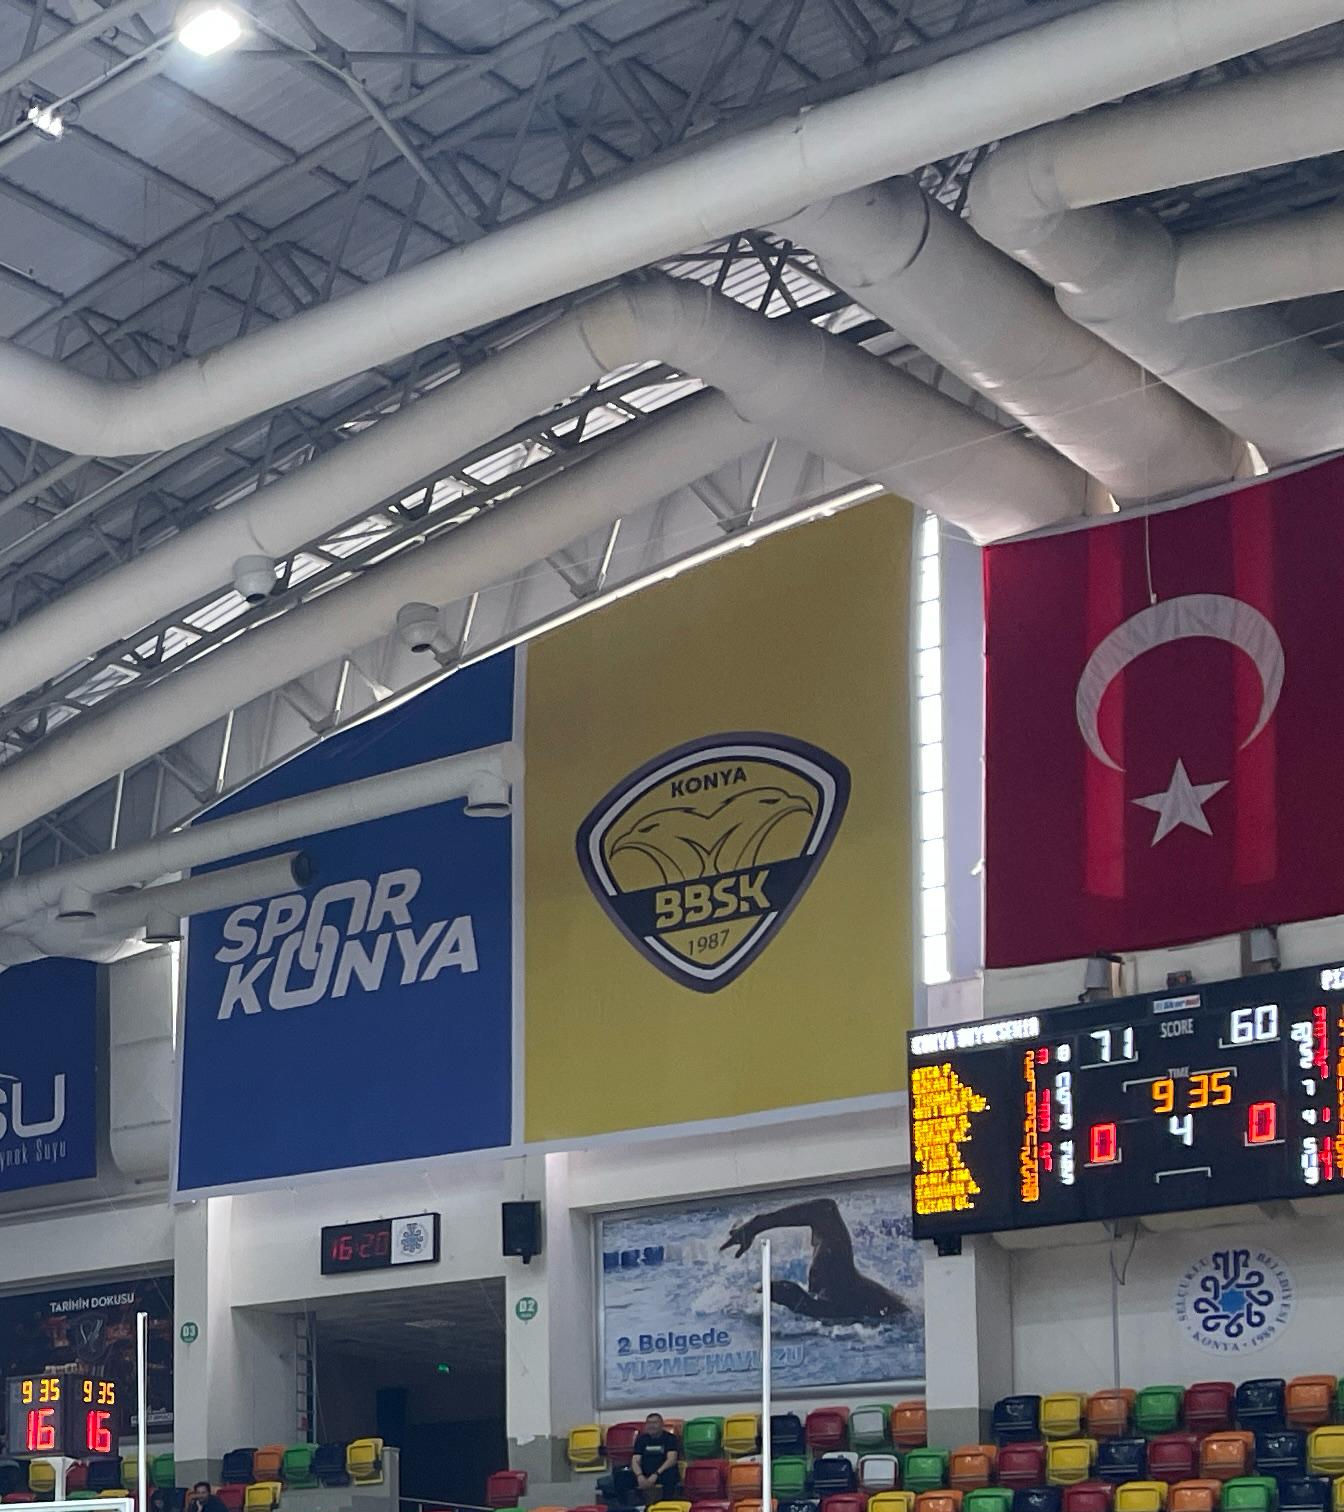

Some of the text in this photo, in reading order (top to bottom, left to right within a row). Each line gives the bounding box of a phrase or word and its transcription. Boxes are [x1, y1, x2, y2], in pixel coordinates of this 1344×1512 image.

[671, 766, 748, 798] KONYA
[655, 868, 772, 931] BBSK
[214, 868, 422, 970] SPOR
[687, 928, 731, 956] 1987
[217, 915, 480, 1020] KONYA
[1160, 1018, 1194, 1039] SCORE
[1229, 1003, 1279, 1044] 60
[1090, 1026, 1135, 1063] 71
[1168, 1113, 1194, 1147] 4
[1247, 1101, 1278, 1144] 0
[35, 1137, 66, 1163] Suyu
[1089, 1122, 1118, 1164] 0
[50, 1292, 136, 1313] TARİHİN DOKUSU
[639, 1328, 731, 1356] Bölgede
[1191, 1330, 1241, 1352] KONYA
[27, 1407, 55, 1451] 16
[86, 1409, 111, 1453] 16
